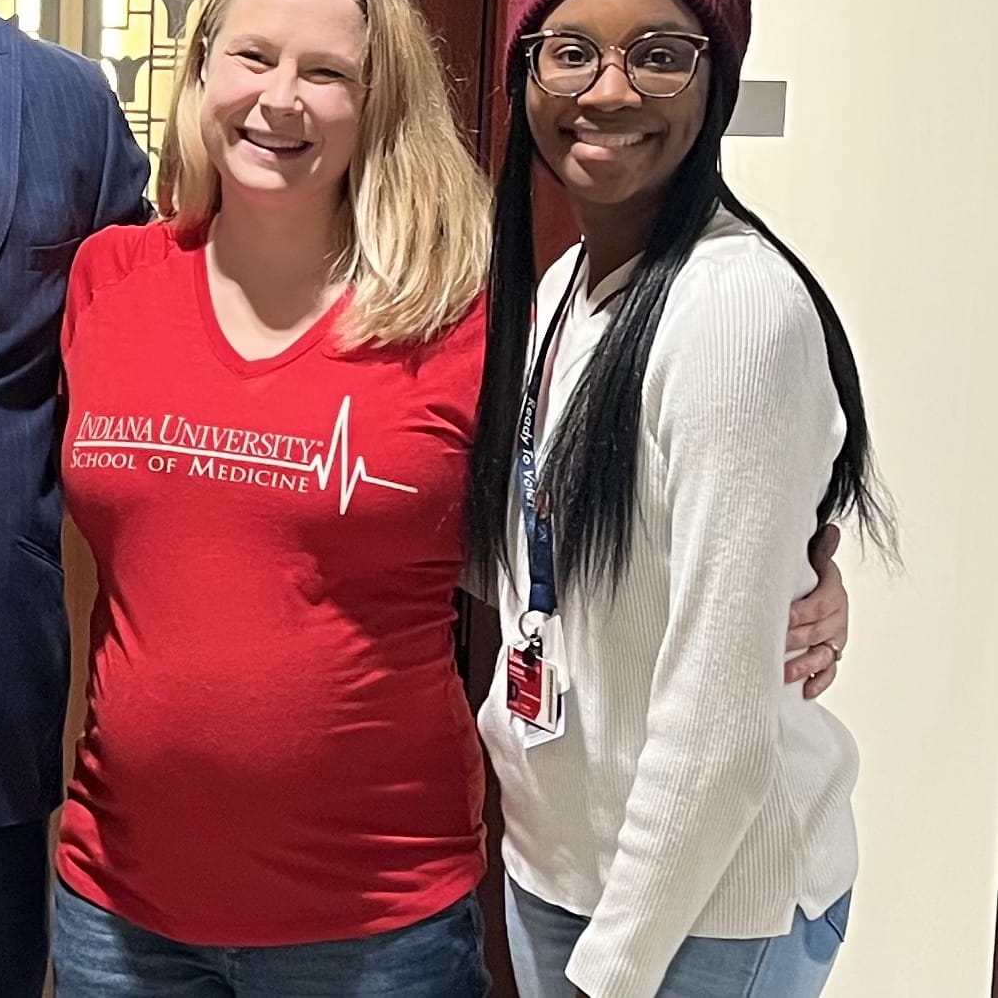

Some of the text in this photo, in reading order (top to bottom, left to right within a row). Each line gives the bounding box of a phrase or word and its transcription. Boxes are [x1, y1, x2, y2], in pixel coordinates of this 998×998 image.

[75, 411, 316, 464] INDIANA UNIVERSITY
[520, 397, 536, 446] Ready
[70, 448, 309, 493] SCHOOL OF MEDICINE
[522, 448, 534, 465] To
